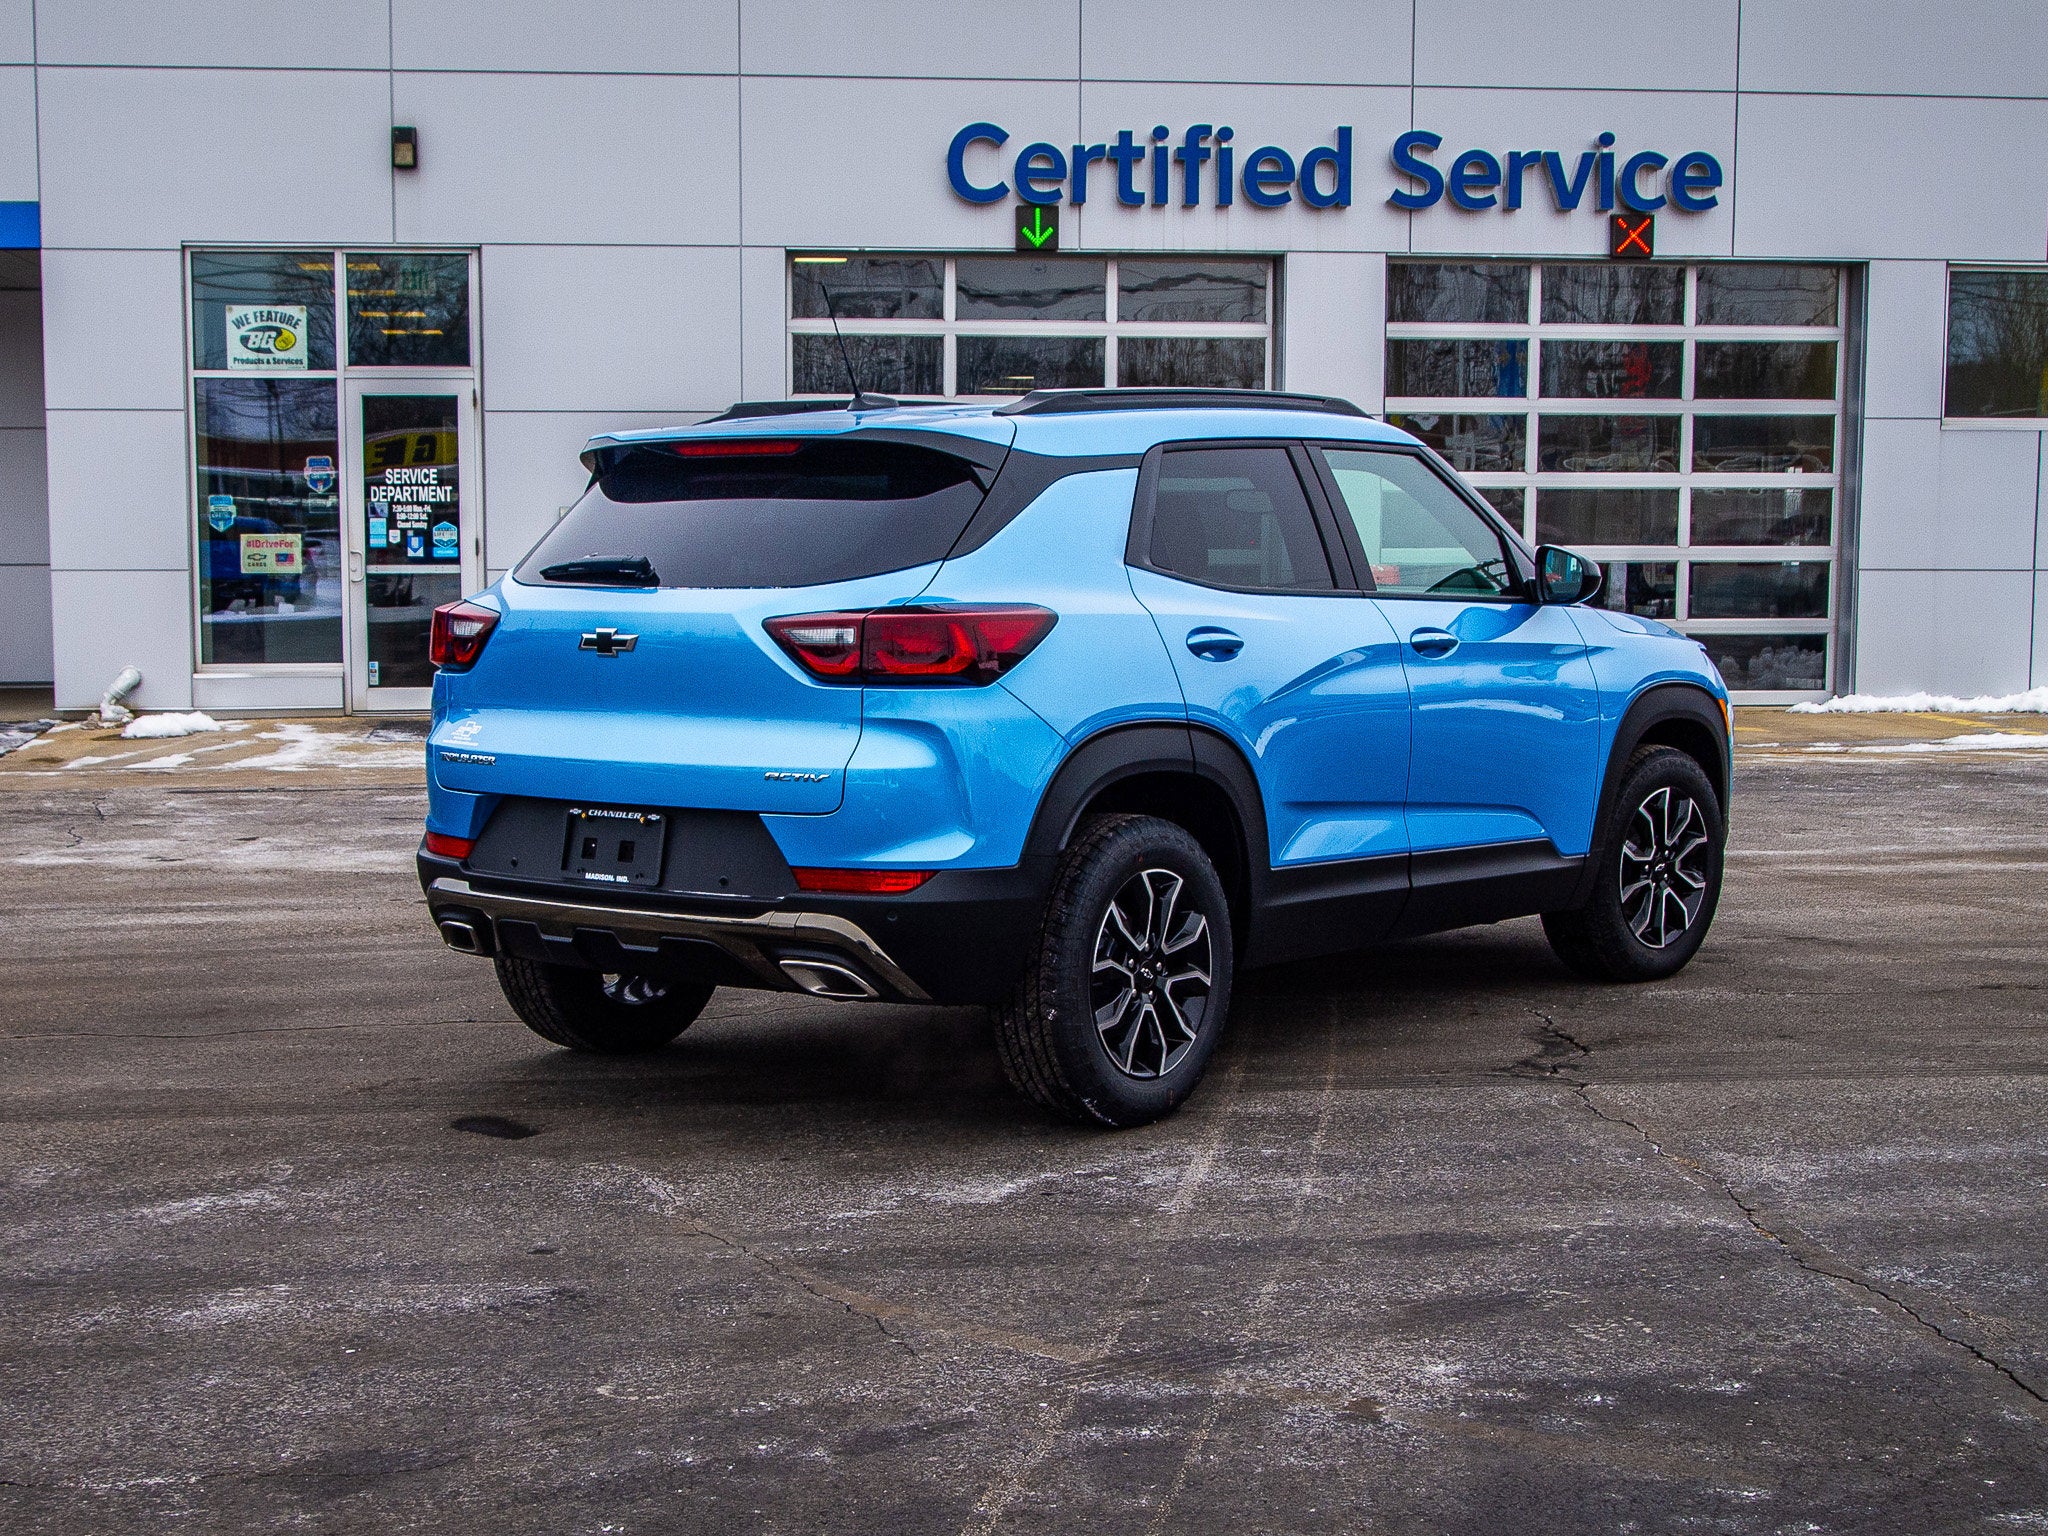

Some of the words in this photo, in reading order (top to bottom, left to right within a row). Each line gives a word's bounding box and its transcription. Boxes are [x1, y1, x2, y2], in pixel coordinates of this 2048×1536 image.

[946, 122, 1353, 207] Certified
[1387, 130, 1724, 212] Service
[231, 313, 251, 330] WE
[253, 310, 302, 330] FEATURE
[233, 357, 264, 365] Products
[272, 357, 304, 365] Services
[385, 468, 438, 485] SERVICE
[370, 486, 453, 502] DEPARTMENT
[412, 521, 427, 530] Sunday
[764, 771, 830, 783] ACTIV
[588, 809, 642, 819] CHANDLER
